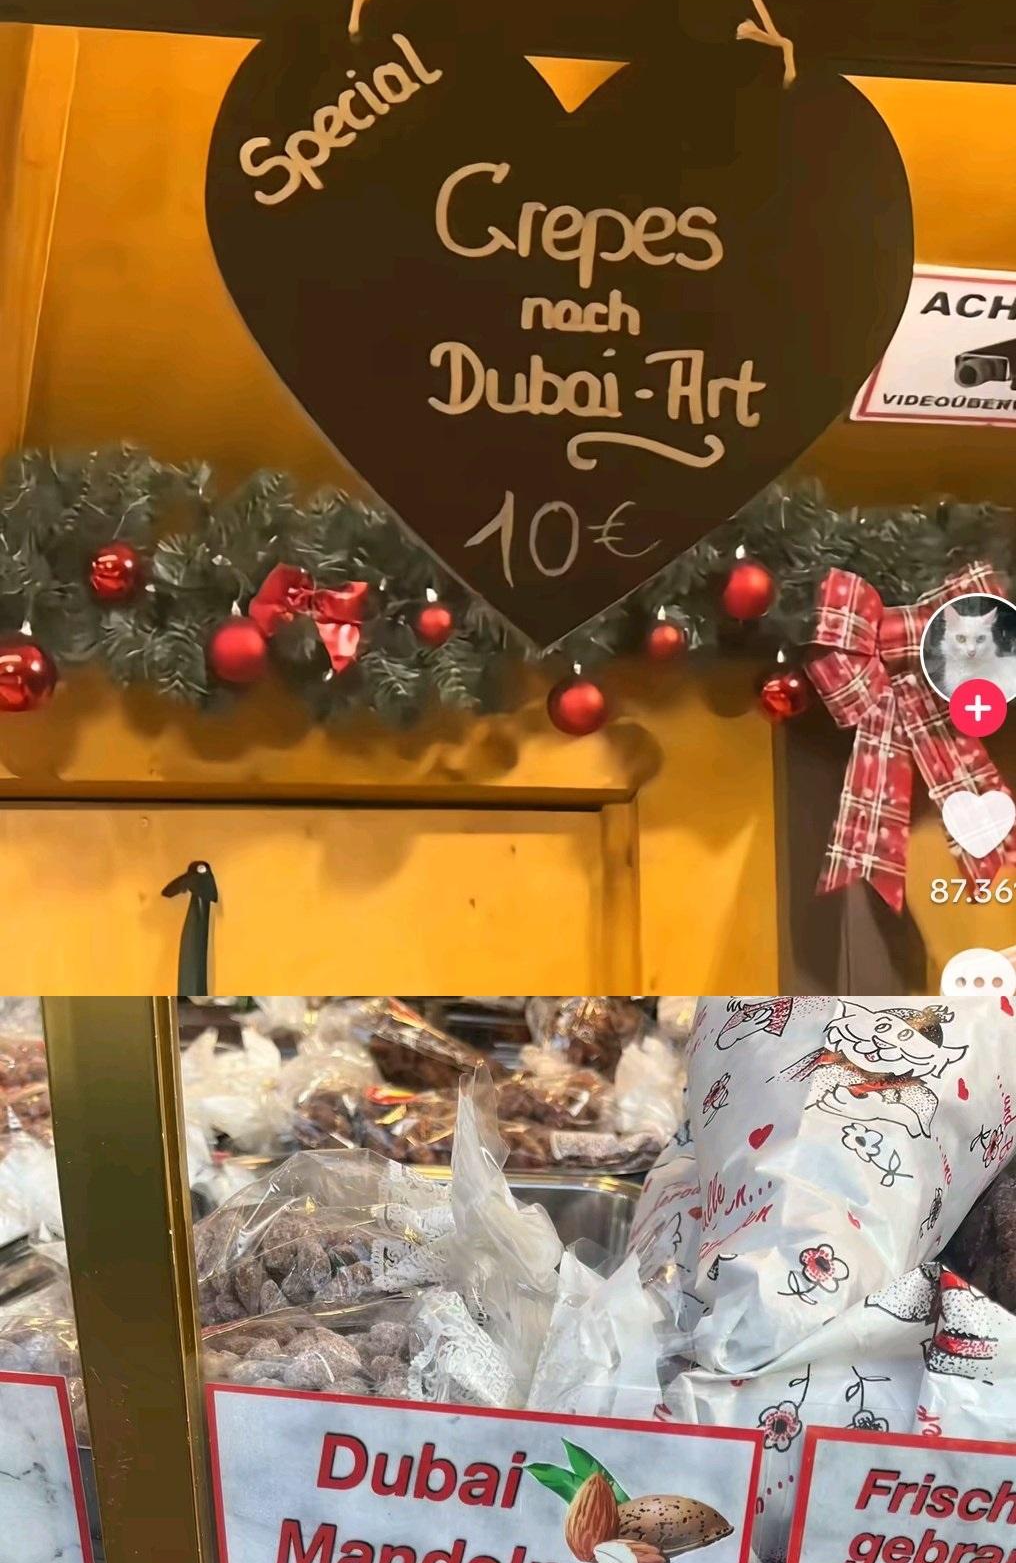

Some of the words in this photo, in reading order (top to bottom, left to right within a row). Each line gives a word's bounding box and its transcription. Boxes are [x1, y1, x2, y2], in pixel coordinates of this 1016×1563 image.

[239, 32, 444, 206] Special
[434, 161, 724, 288] Crepes
[520, 289, 641, 335] nach
[463, 490, 662, 588] 10€
[316, 1432, 527, 1509] Dubai
[855, 1468, 1016, 1525] Frisch
